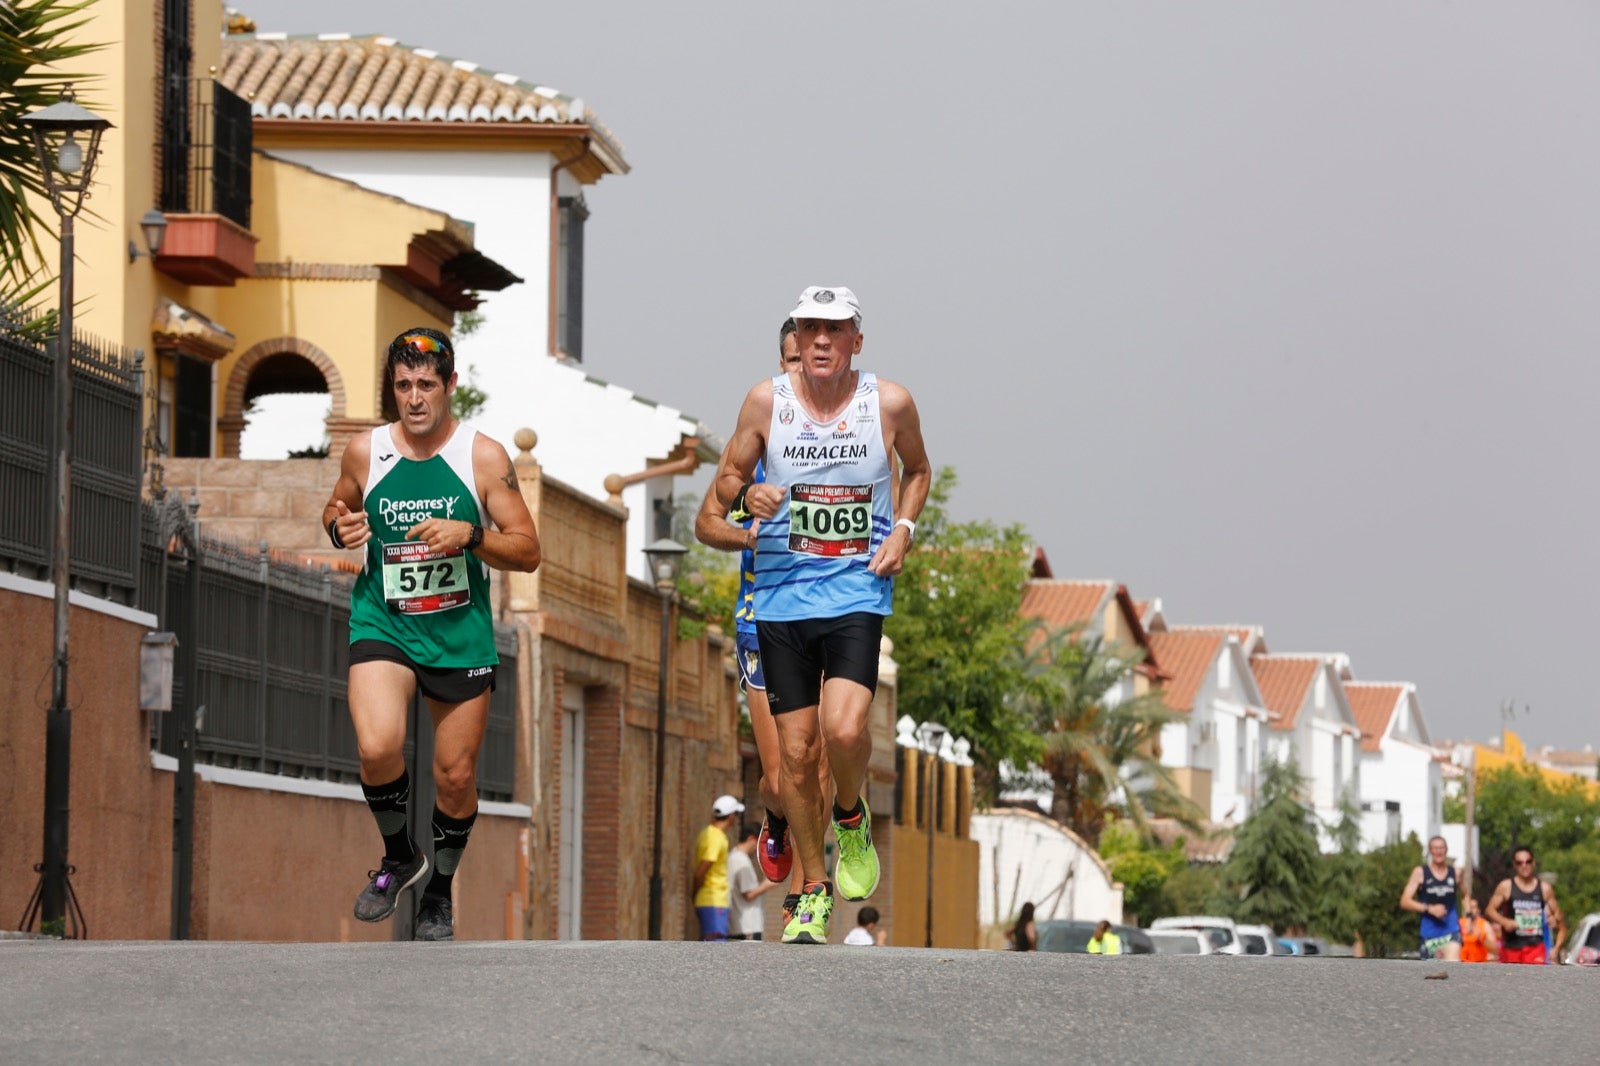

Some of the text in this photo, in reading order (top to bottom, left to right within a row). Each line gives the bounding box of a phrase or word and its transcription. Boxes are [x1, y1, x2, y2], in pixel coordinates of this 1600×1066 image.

[783, 444, 867, 460] MARACENA
[810, 486, 824, 495] GRAN
[825, 487, 844, 496] PREMIO
[845, 487, 851, 495] DE
[852, 486, 869, 496] FONDO
[796, 506, 869, 534] 1069
[400, 545, 415, 555] GRAN
[415, 544, 429, 554] PREM
[399, 562, 456, 592] 572
